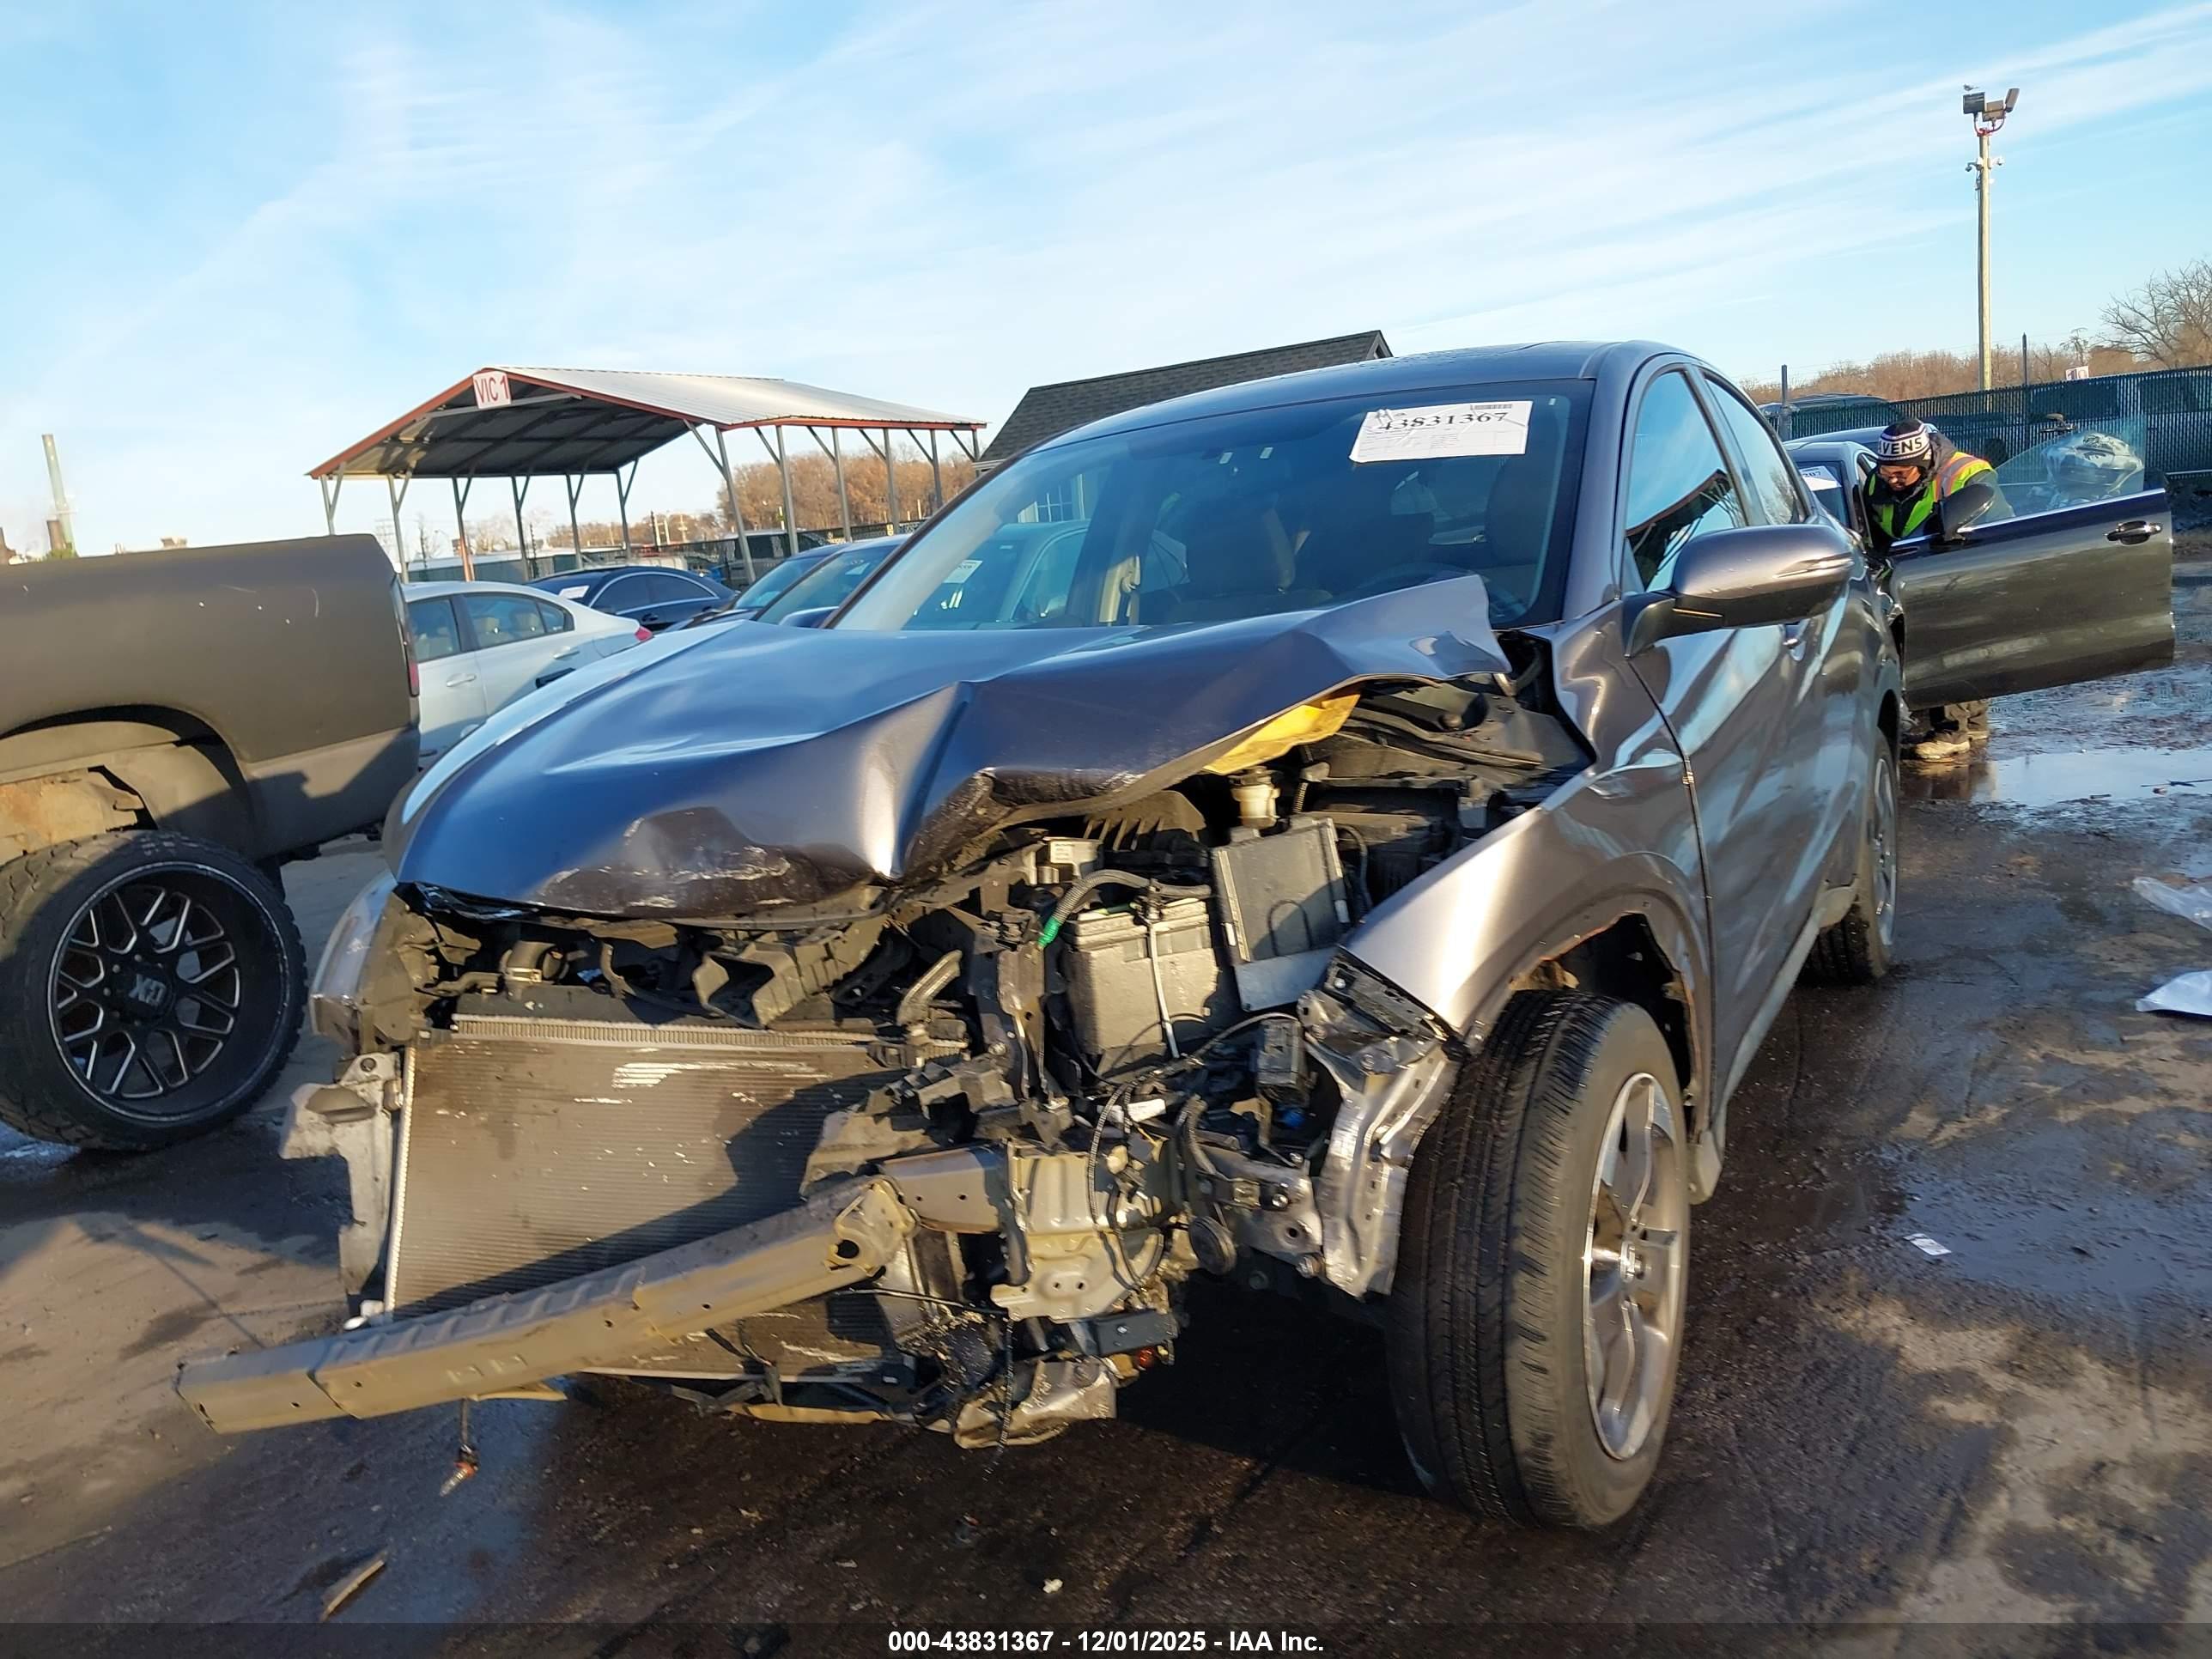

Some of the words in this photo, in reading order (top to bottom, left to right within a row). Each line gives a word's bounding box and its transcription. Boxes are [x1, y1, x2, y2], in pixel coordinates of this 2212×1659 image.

[475, 376, 499, 404] VIC
[500, 374, 509, 399] 1
[1377, 412, 1509, 431] 43831367
